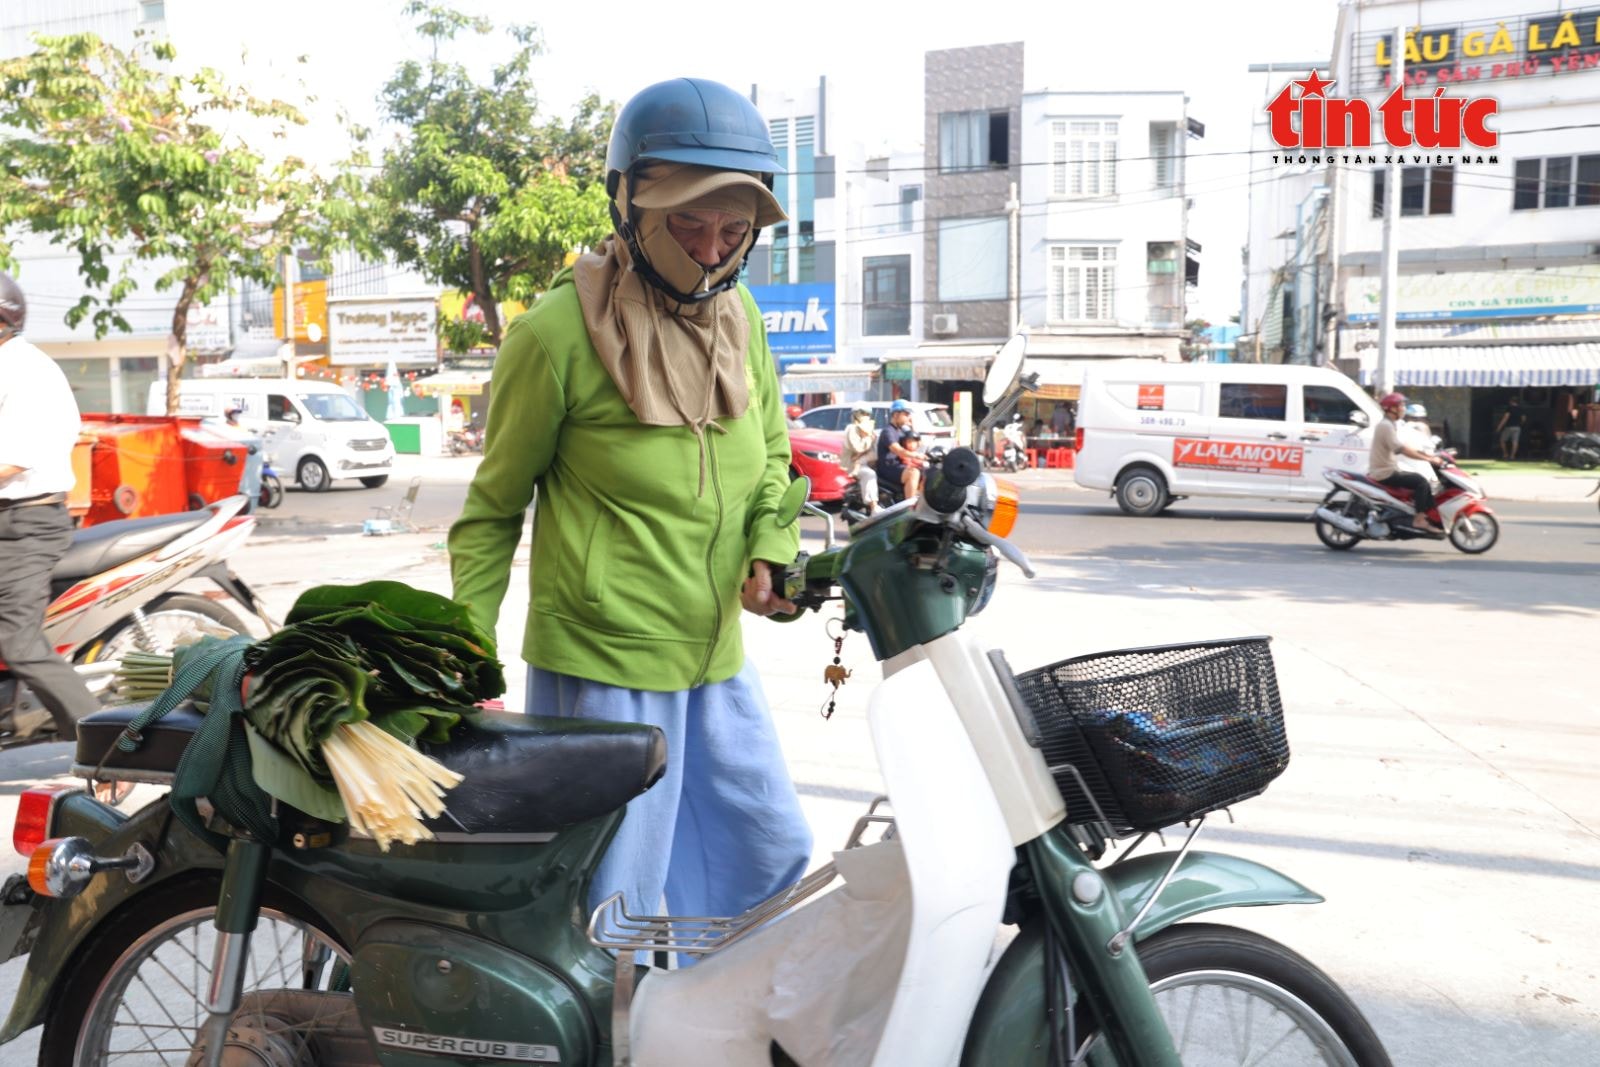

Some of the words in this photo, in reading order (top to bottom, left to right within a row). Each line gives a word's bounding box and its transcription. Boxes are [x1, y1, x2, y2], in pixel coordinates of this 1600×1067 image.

[1462, 21, 1514, 58] GÀ
[1528, 11, 1581, 51] LÁ
[1490, 54, 1540, 79] PHÚ
[1551, 49, 1600, 73] YÊN
[762, 297, 830, 332] ank
[1449, 299, 1476, 308] CON
[1195, 442, 1301, 464] LALAMOVE
[383, 1030, 457, 1051] SUPER
[460, 1041, 507, 1056] CUB
